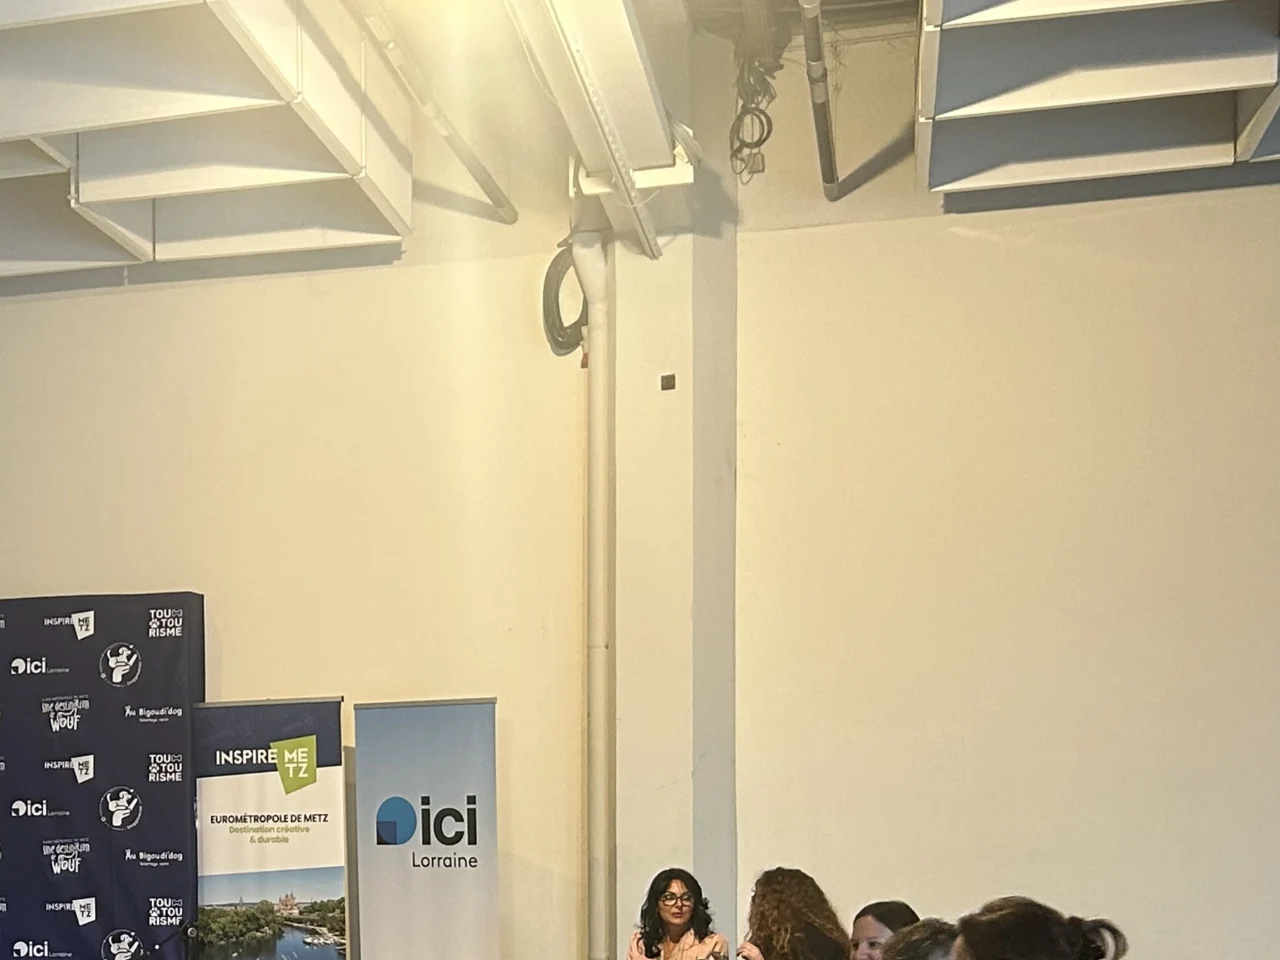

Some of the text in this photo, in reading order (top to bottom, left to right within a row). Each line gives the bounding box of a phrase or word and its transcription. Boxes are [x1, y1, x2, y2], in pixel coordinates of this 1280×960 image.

[149, 609, 171, 619] TOU
[44, 617, 74, 626] INSPIRE
[160, 618, 182, 628] TOU
[149, 627, 182, 637] RISME
[26, 657, 46, 674] ici
[149, 754, 171, 763] TOU
[216, 749, 278, 765] INSPIRE
[44, 761, 74, 769] INSPIRE
[160, 763, 182, 772] TOU
[149, 772, 182, 782] RISME
[27, 799, 47, 816] ici
[210, 812, 328, 824] EUROMÉTROPOLE DE METZ
[421, 795, 477, 846] ici
[229, 825, 310, 834] Destination créative
[257, 835, 289, 843] durable
[412, 852, 478, 868] Lorraine
[45, 903, 76, 911] INSPIRE
[149, 898, 171, 907] TOU
[161, 907, 182, 916] TOU
[149, 916, 182, 926] RISME
[28, 940, 48, 957] ici
